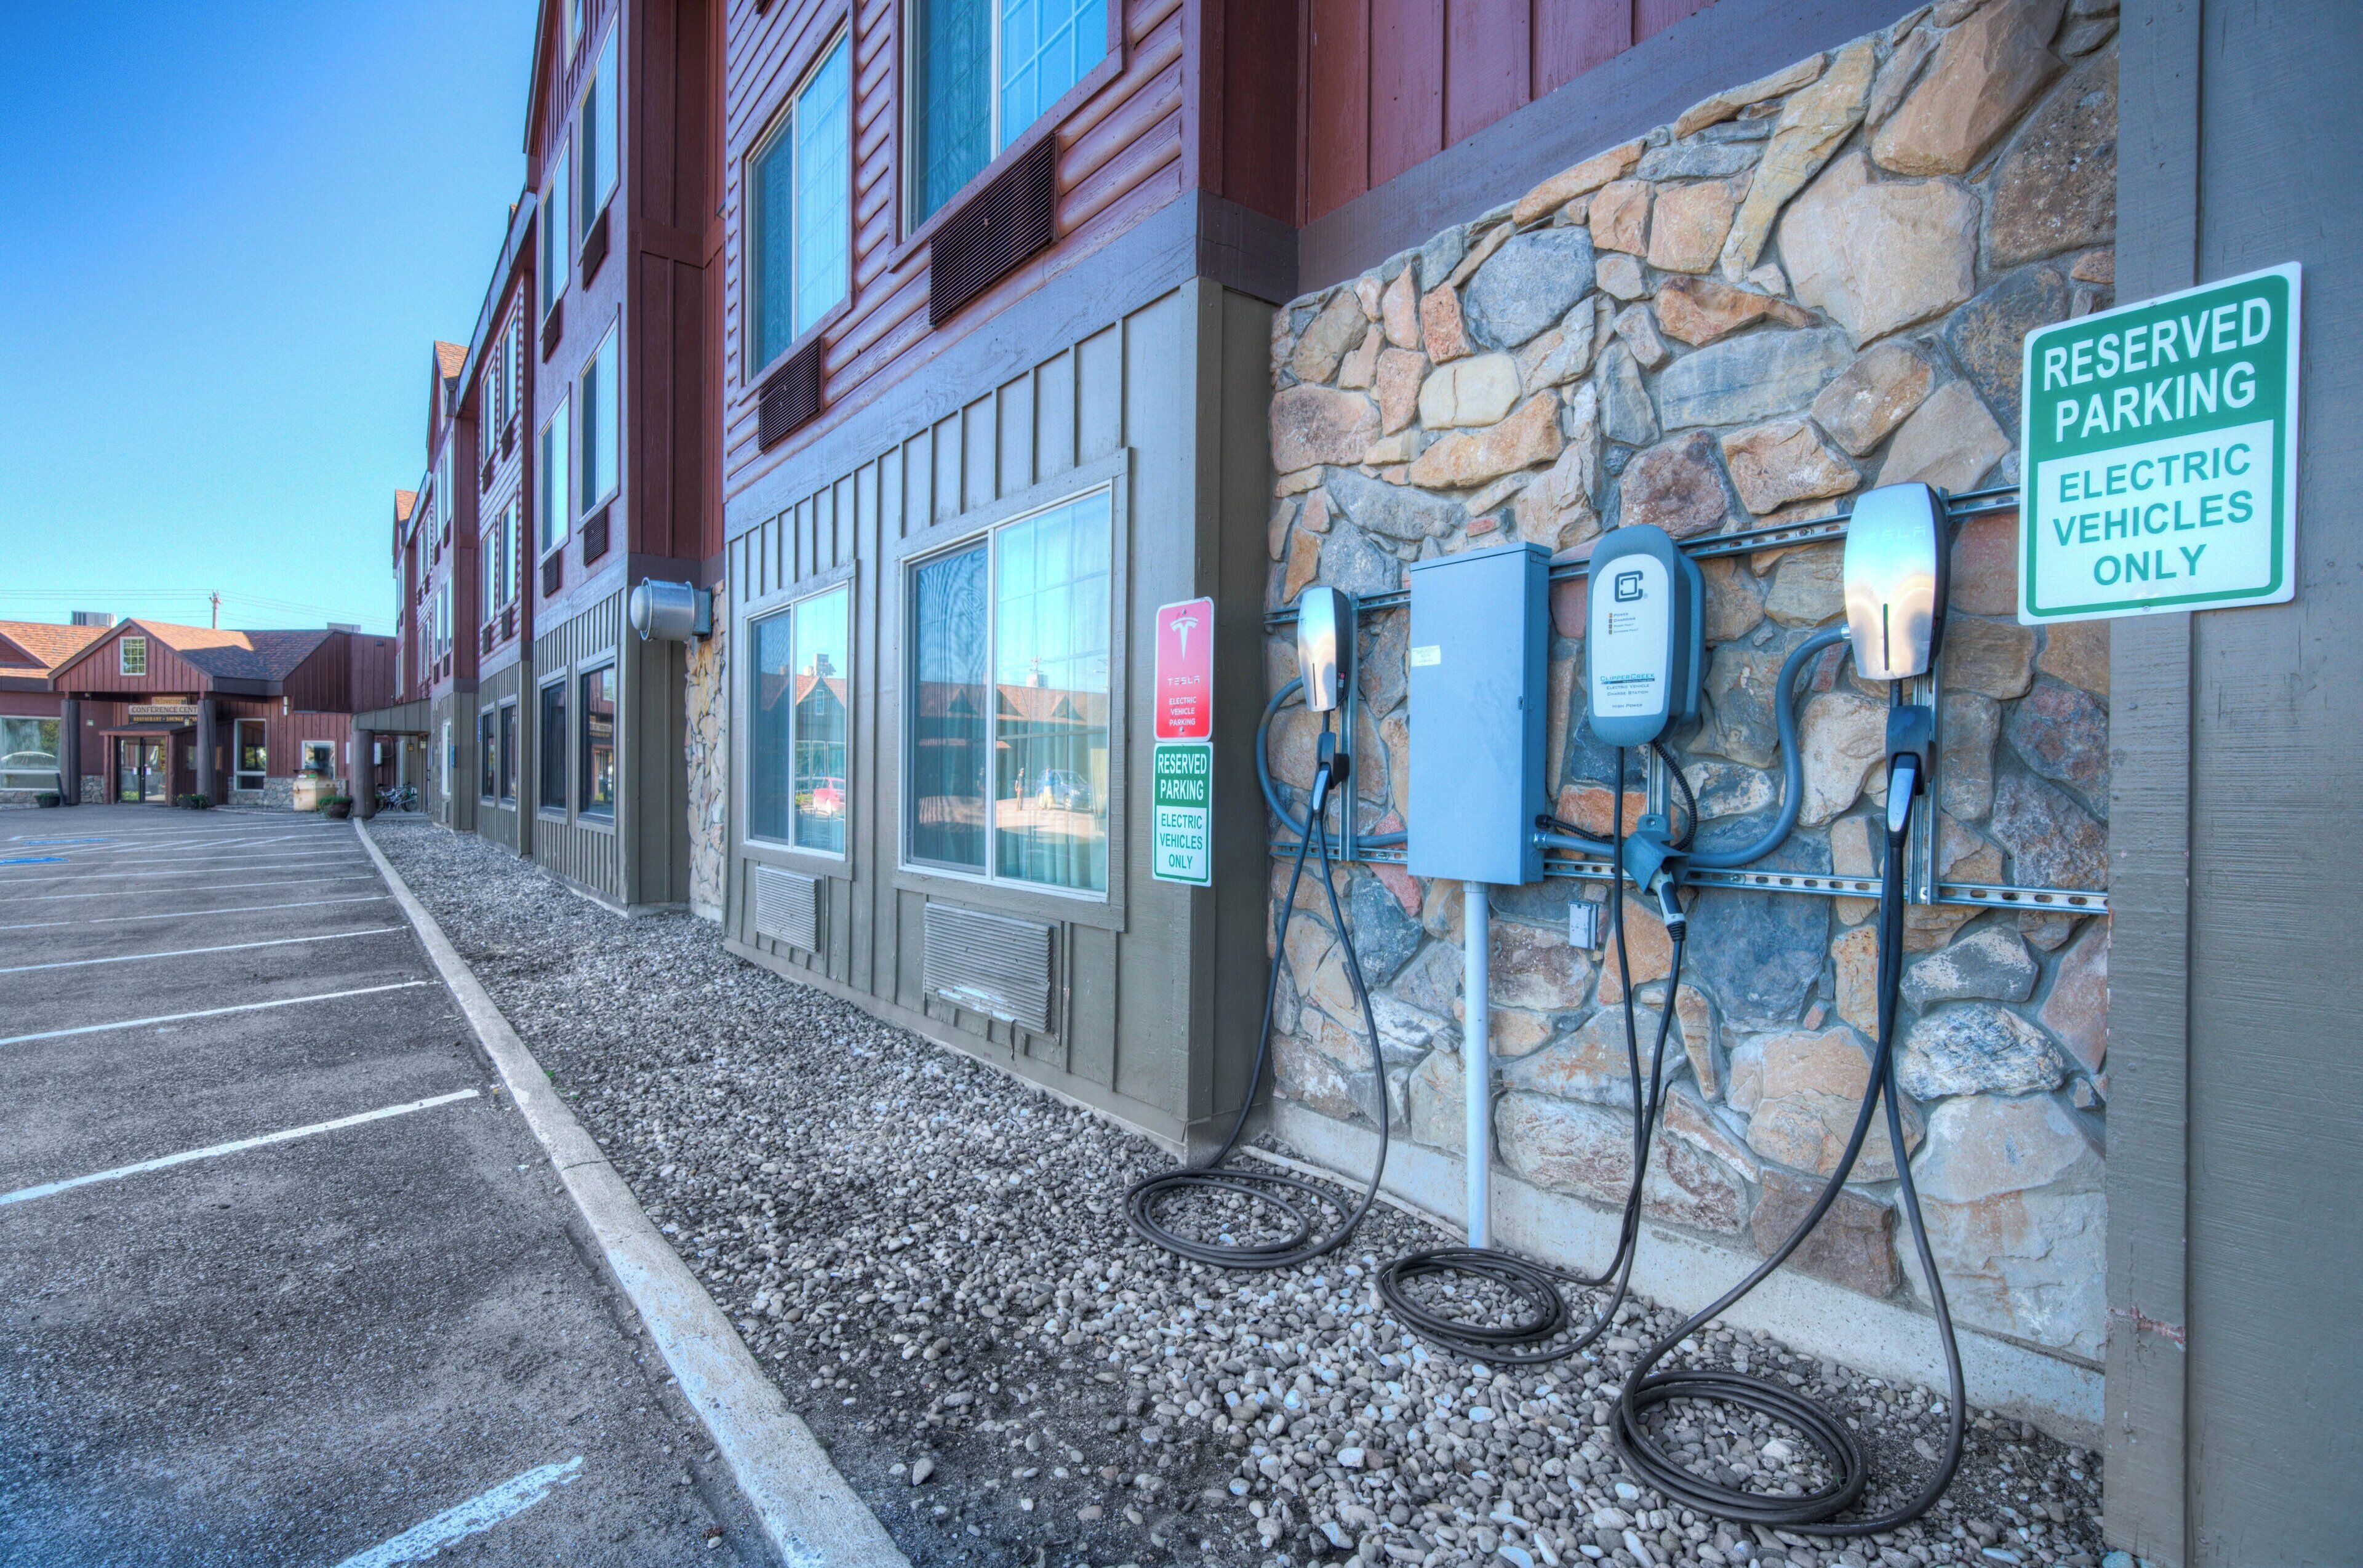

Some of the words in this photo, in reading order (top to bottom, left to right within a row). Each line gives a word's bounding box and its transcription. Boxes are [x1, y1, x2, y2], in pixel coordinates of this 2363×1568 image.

[2043, 296, 2272, 391] RESERVED
[2055, 361, 2256, 442] PARKING
[2059, 443, 2251, 503] ELECTRIC
[2053, 490, 2253, 546] VEHICLES
[2093, 543, 2207, 586] ONLY
[1167, 675, 1200, 686] TESLA
[1169, 696, 1197, 705] ELECTRIC
[1170, 707, 1195, 716] VEHICLE
[1169, 718, 1196, 726] PARKING
[1158, 753, 1207, 774] RESERVED
[1160, 779, 1204, 801] PARKING
[1161, 814, 1202, 830] ELECTRIC
[1160, 833, 1202, 850] VEHICLES
[1169, 854, 1193, 870] ONLY
